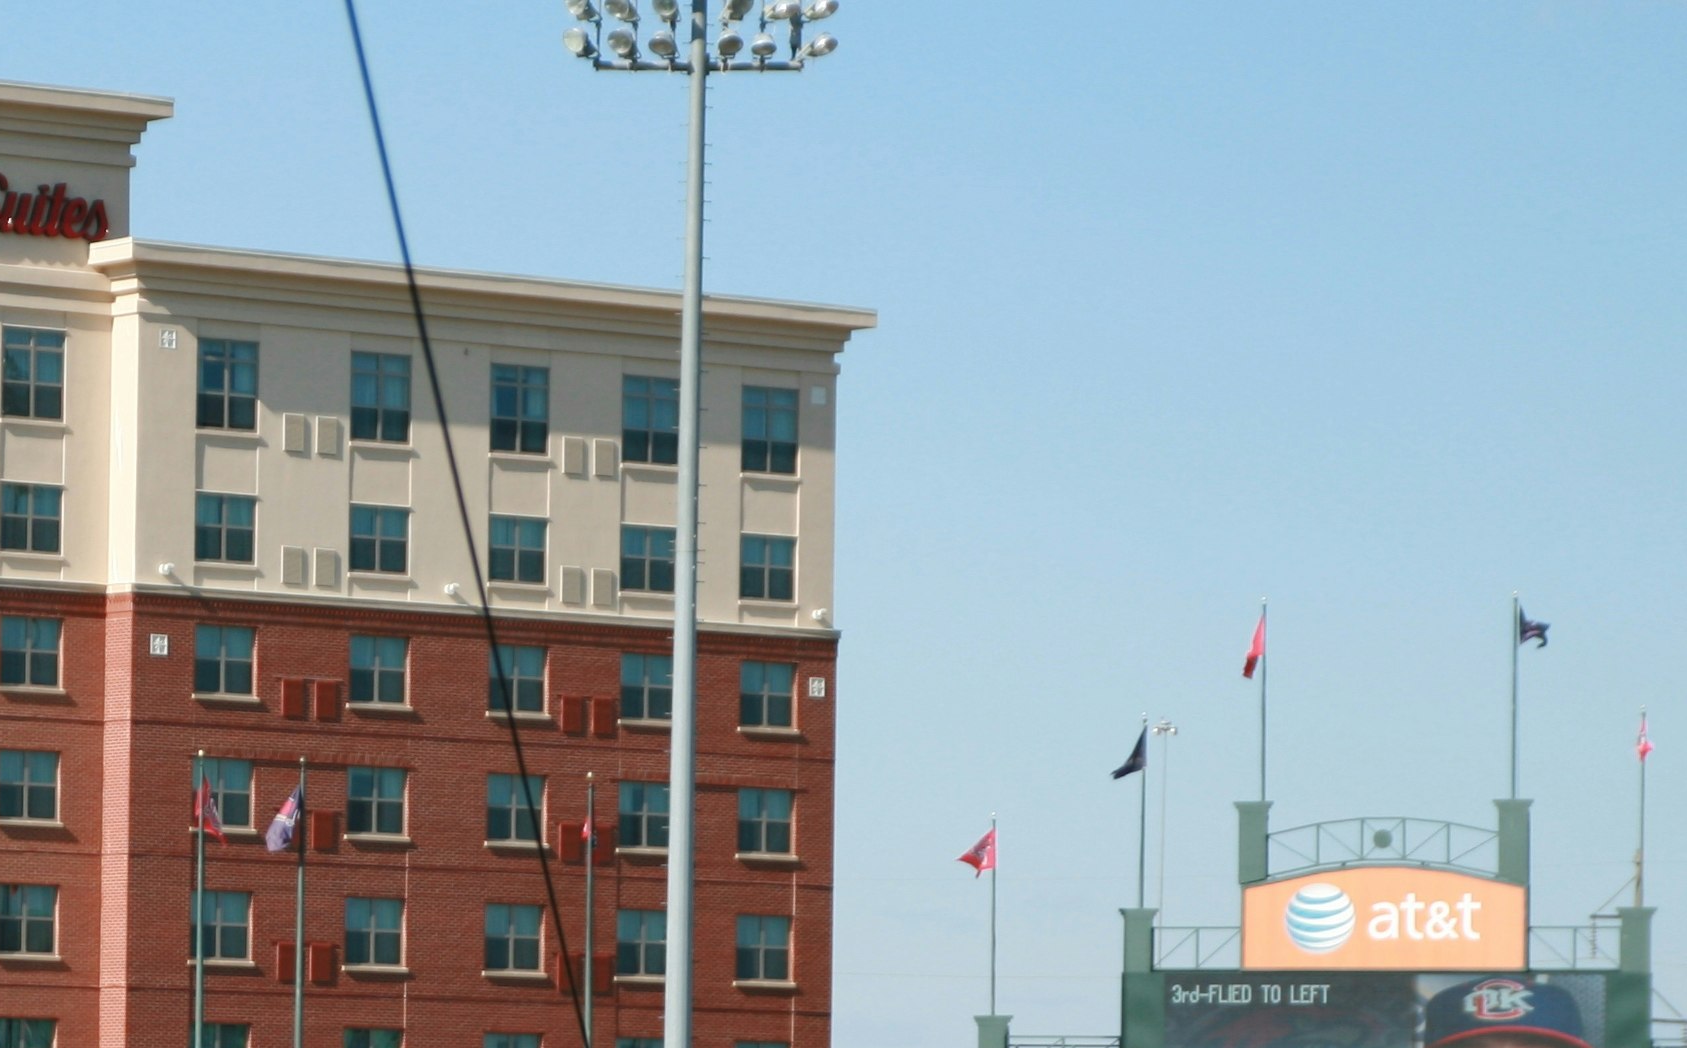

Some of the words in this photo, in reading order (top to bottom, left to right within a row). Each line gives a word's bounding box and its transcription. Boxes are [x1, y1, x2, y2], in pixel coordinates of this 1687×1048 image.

[1368, 892, 1481, 941] at&t
[1171, 984, 1252, 1004] 3rd-FLIED
[1261, 984, 1282, 1004] TO
[1290, 984, 1330, 1004] LEFT
